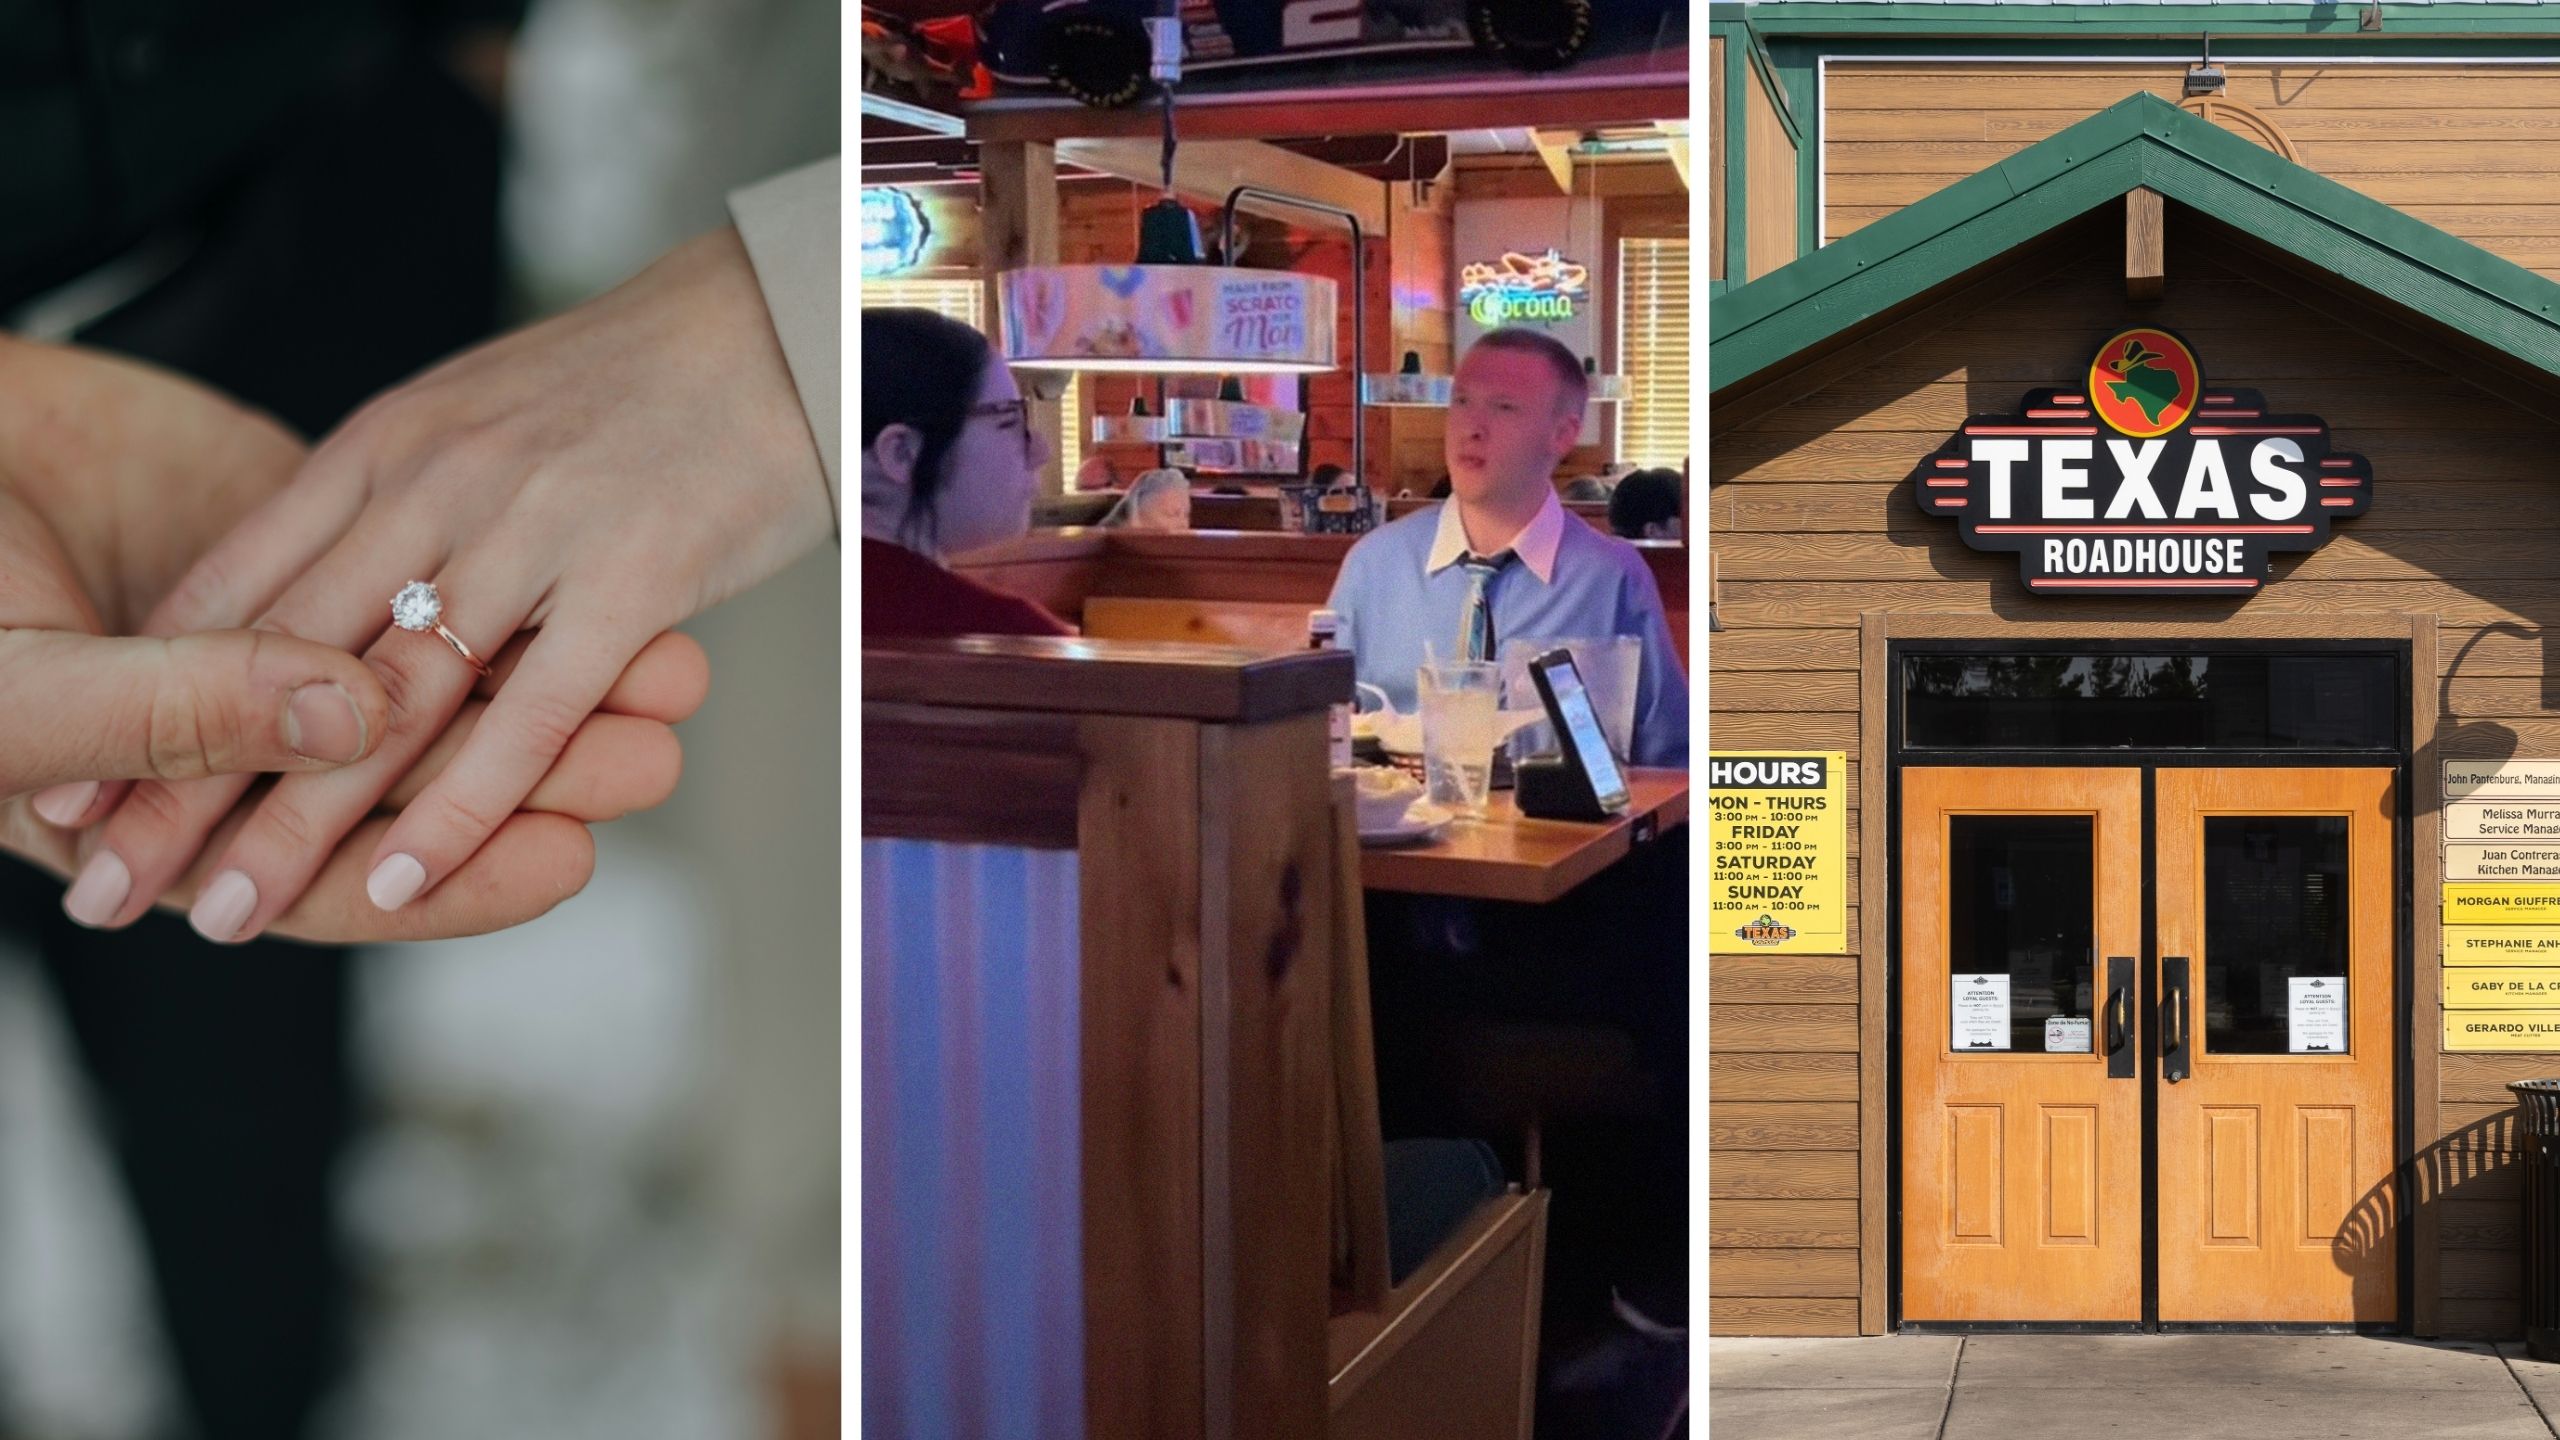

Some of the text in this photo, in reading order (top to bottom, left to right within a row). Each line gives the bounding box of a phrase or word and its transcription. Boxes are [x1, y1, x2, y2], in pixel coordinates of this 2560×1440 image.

[1470, 292, 1573, 326] Corona
[1971, 437, 2307, 521] TEXAS
[2043, 538, 2244, 574] ROADHOUSE
[1711, 761, 1821, 785] HOURS
[2448, 774, 2469, 784] John
[2470, 774, 2522, 785] Pantenburg,
[1709, 796, 1748, 810] MON
[1765, 796, 1827, 810] THURS
[1714, 812, 1743, 821] 3:00
[1770, 812, 1803, 821] 10:00
[2482, 809, 2560, 819] Melissa Murra
[1732, 825, 1800, 839] FRIDAY
[2479, 824, 2520, 834] Service
[1715, 841, 1743, 850] 3:00
[1771, 841, 1802, 850] 11:00
[2482, 850, 2507, 860] Juan
[1716, 855, 1817, 869] SATURDAY
[2478, 864, 2518, 875] Kitchen
[1713, 871, 1744, 881] 11:00
[1772, 871, 1803, 881] 11:00
[1728, 885, 1804, 899] SUNDAY
[1713, 901, 1743, 911] 11:00
[1771, 901, 1805, 911] 10:00
[2457, 897, 2510, 906] MORGAN
[1744, 927, 1788, 939] TEXAS
[2466, 939, 2560, 948] STEPHANIE ANH
[2471, 982, 2504, 991] GABY
[2509, 982, 2524, 991] DE
[2528, 982, 2545, 991] LA
[2466, 1024, 2560, 1032] GERARDO VILLE
